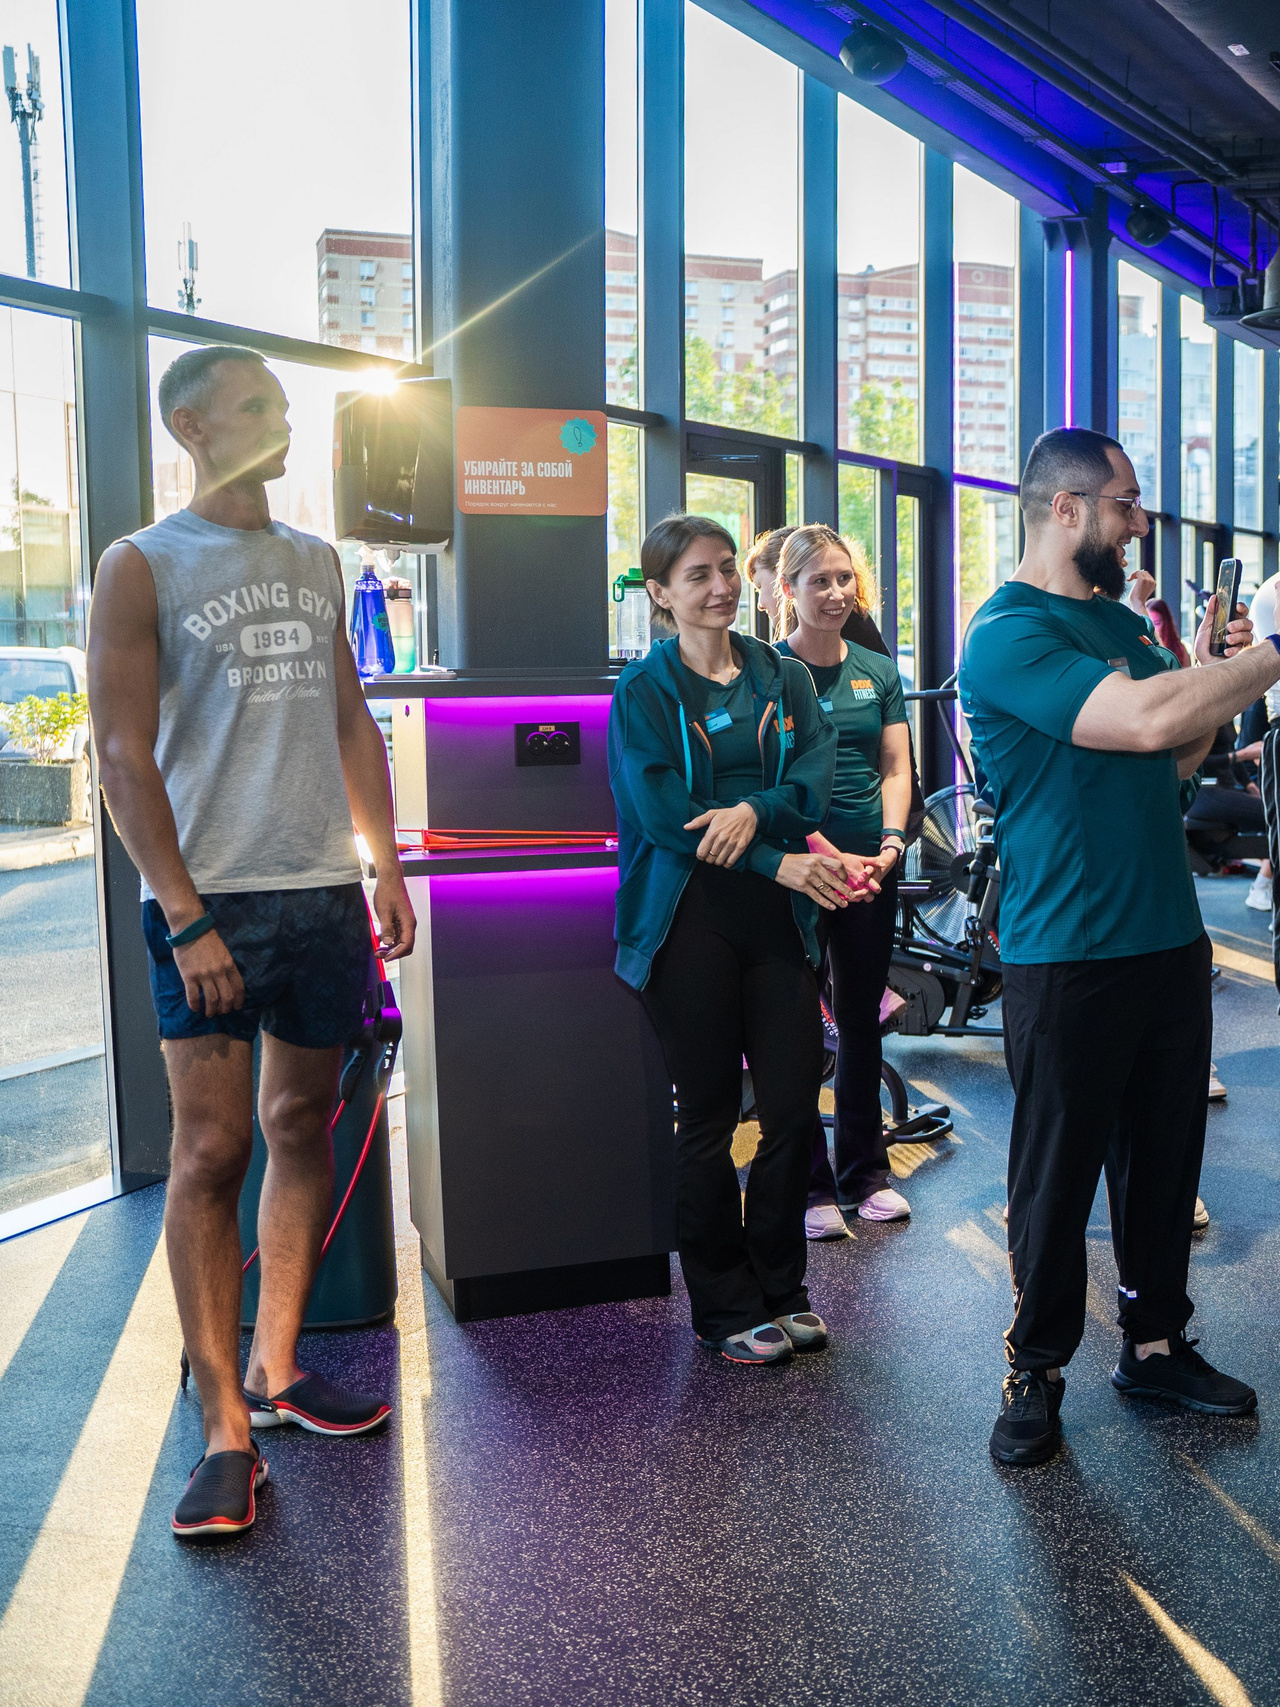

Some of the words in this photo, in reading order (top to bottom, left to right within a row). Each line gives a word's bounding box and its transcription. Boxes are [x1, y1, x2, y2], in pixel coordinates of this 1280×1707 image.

[464, 458, 518, 476] УБИРАЙТЕ
[521, 461, 534, 477] ЗА
[537, 460, 573, 478] СОБОЙ
[464, 479, 526, 495] ИНВЕНТАРЬ
[182, 582, 290, 642] BOXING
[298, 587, 338, 621] GYM
[215, 643, 235, 653] USA
[253, 628, 300, 649] 1984
[316, 635, 329, 644] NYC
[227, 660, 327, 688] BROOKLYN
[285, 682, 321, 700] States
[850, 679, 874, 690] DDX
[853, 689, 877, 700] FITNESS
